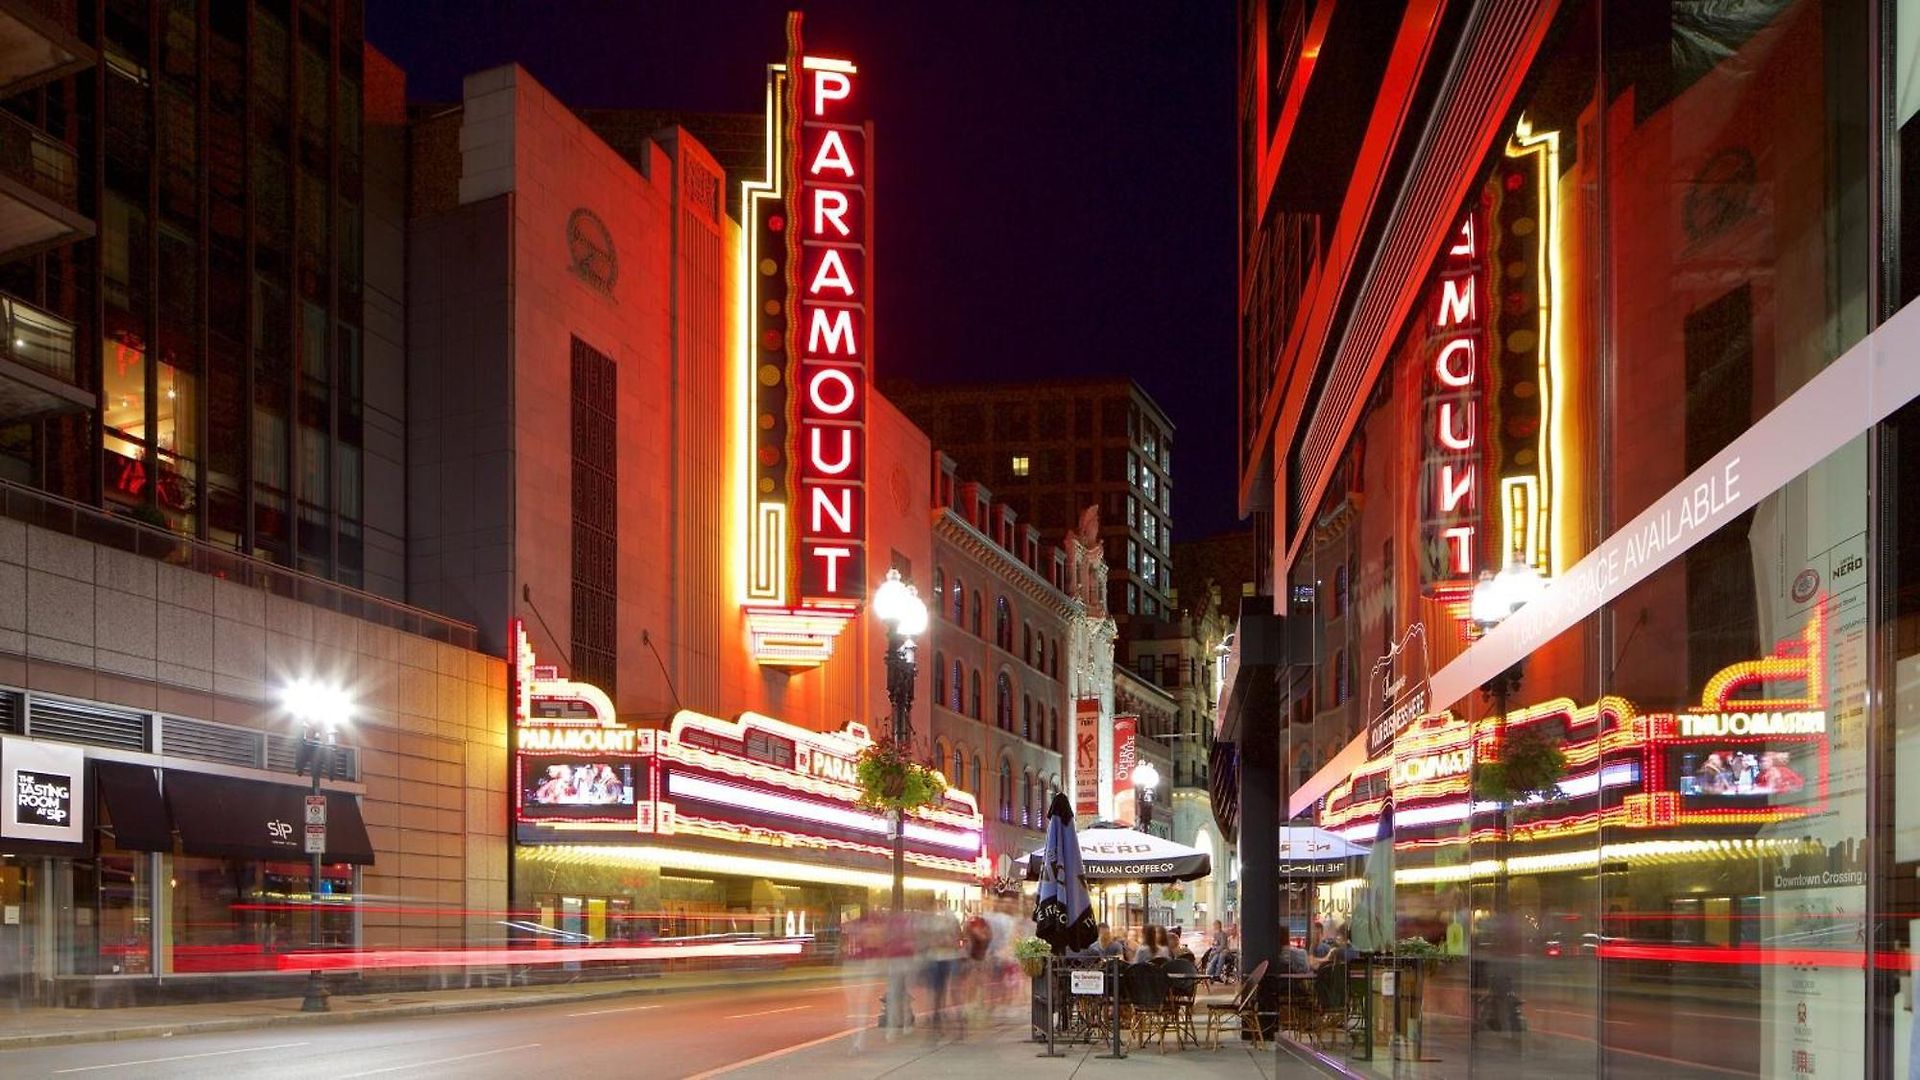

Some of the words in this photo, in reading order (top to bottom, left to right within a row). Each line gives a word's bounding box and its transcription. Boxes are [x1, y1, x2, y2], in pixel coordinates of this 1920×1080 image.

[808, 71, 857, 592] PARAMOUNT
[1566, 548, 1619, 613] SPACE
[1623, 457, 1741, 576] AVAILABLE
[1832, 557, 1863, 580] NERO
[518, 728, 635, 750] PARAMOUNT
[1127, 735, 1136, 768] HOUSE
[19, 775, 34, 783] THE
[19, 794, 60, 809] ROOM
[1081, 844, 1151, 854] NERO
[1088, 865, 1122, 874] ITALIAN
[1124, 864, 1160, 874] COFFEE
[1774, 872, 1821, 888] Downtown
[1822, 870, 1863, 885] Crossing
